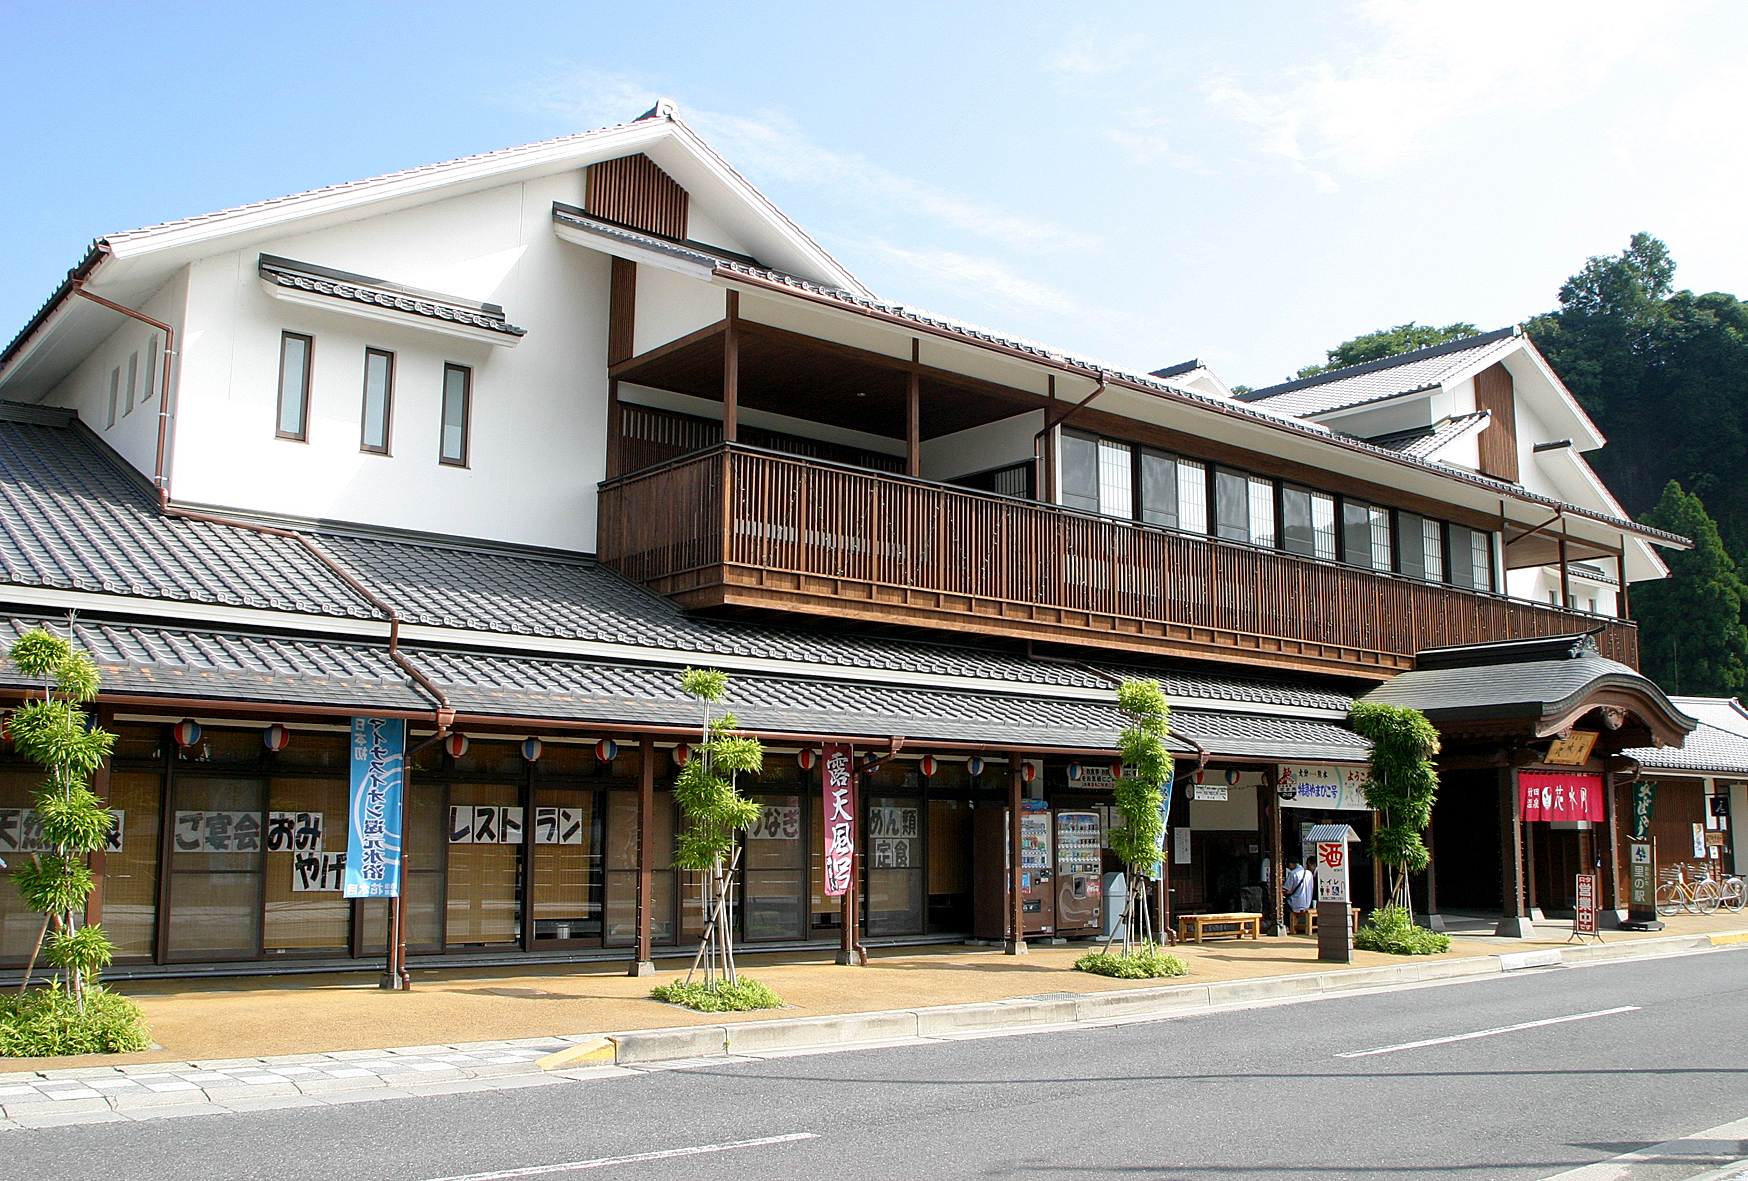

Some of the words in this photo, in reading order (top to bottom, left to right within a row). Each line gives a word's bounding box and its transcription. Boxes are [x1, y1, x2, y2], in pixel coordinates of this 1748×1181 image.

[1554, 784, 1588, 813] 花水月
[175, 812, 261, 851] ご宴会
[267, 812, 322, 851] おみ
[449, 806, 581, 843] レストラン
[826, 751, 854, 890] 露天風呂
[869, 808, 916, 836] めん類
[876, 840, 908, 867] 定食
[1634, 865, 1645, 902] 里の駅
[1578, 883, 1592, 924] 営業中
